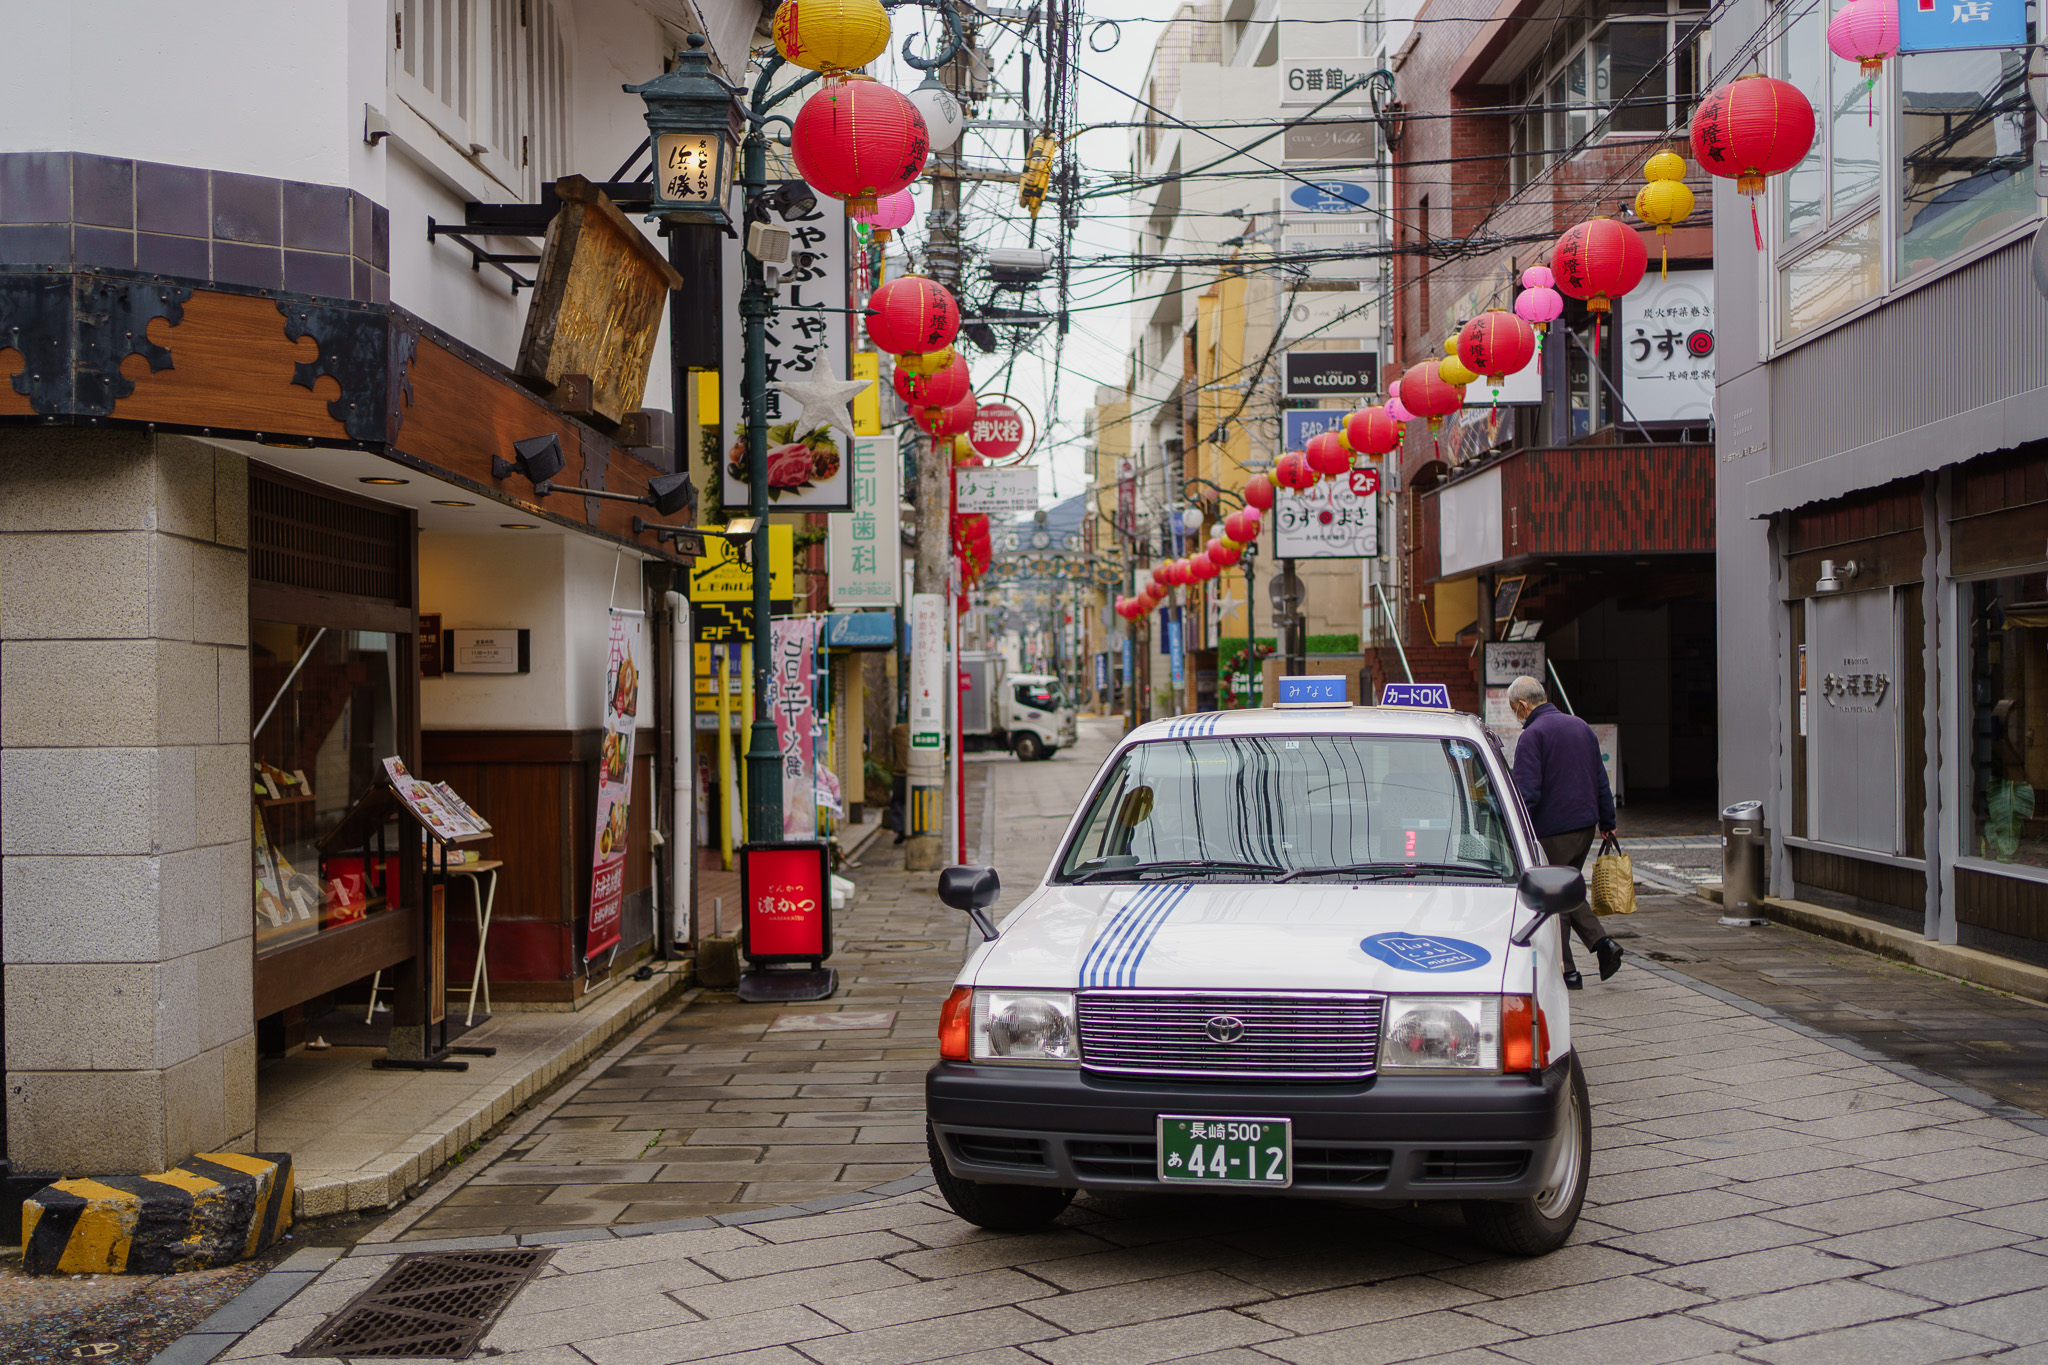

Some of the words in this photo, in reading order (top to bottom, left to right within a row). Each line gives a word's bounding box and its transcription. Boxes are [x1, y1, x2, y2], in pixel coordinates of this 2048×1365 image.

[1950, 0, 1993, 24] 店
[1643, 306, 1714, 318] 炭火野菜巻き
[1630, 329, 1683, 361] うず
[1313, 375, 1356, 386] CLOUD
[1360, 374, 1369, 385] 9
[973, 420, 1021, 442] 消火栓
[1353, 473, 1375, 491] 2F
[702, 627, 732, 640] 2F
[1289, 685, 1333, 698] みなと
[1387, 688, 1443, 705] カードOK
[768, 885, 804, 893] とんかつ
[1390, 941, 1432, 951] blue
[1409, 947, 1447, 957] cab
[1427, 955, 1468, 966] minato
[1167, 1151, 1183, 1168] あ
[1188, 1144, 1284, 1180] 44-12
